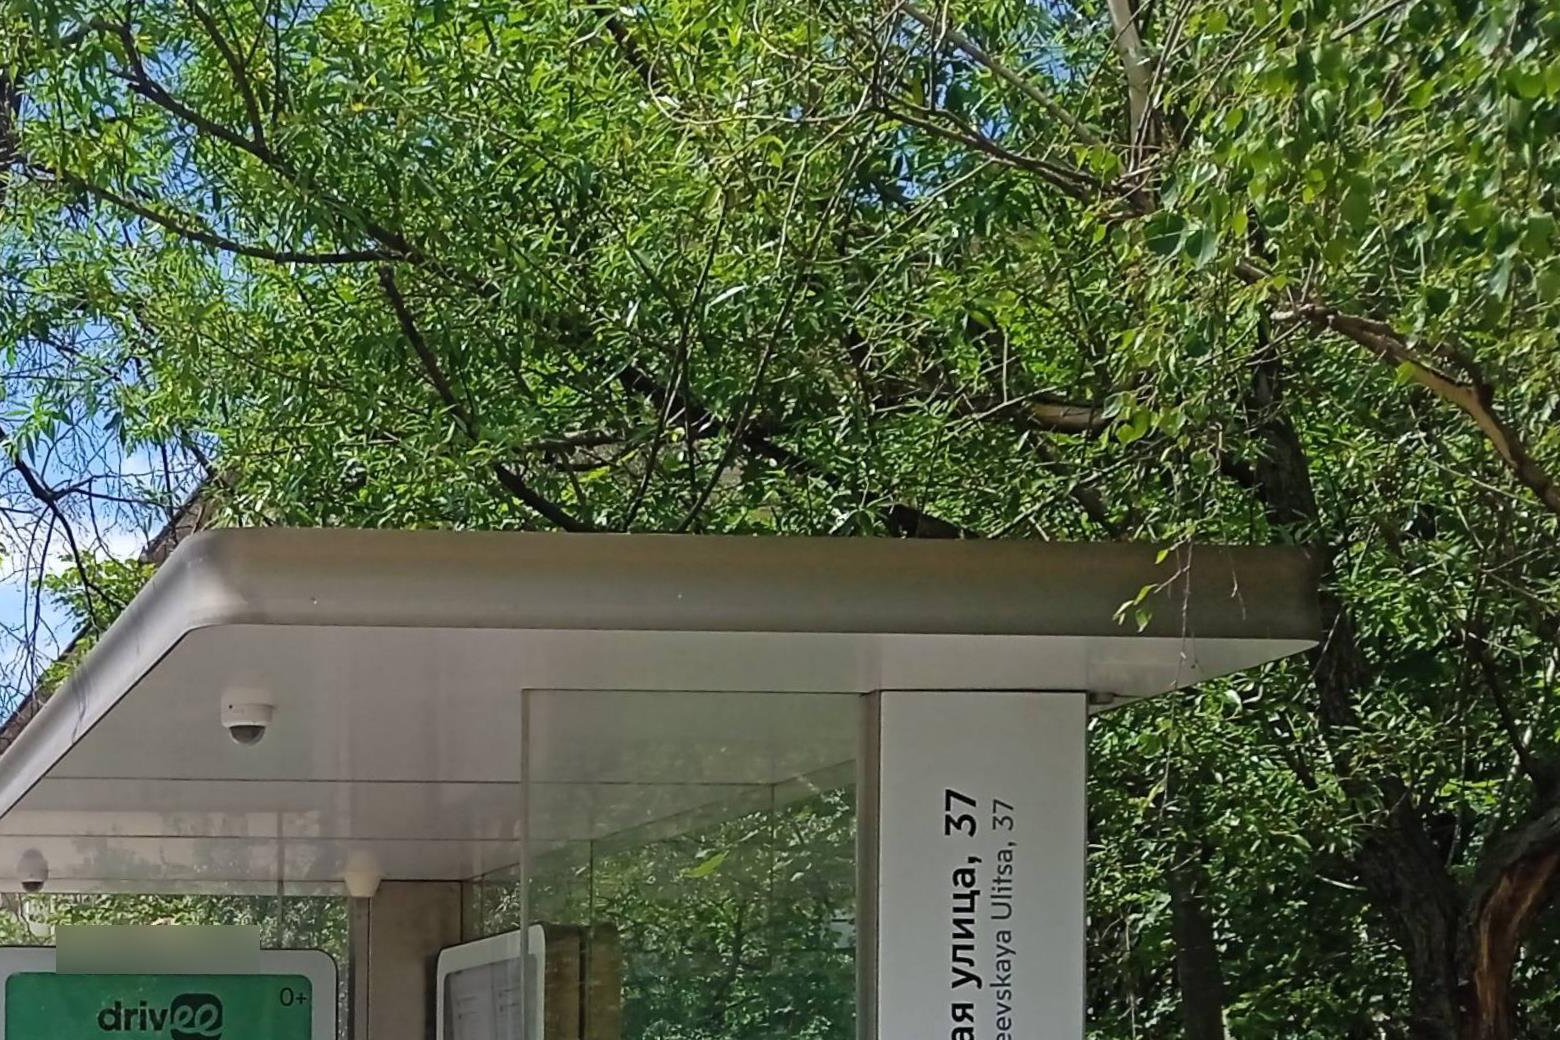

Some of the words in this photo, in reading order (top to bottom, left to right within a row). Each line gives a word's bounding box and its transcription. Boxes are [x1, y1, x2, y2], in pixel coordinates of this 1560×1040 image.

[944, 788, 977, 838] 37
[992, 798, 1015, 832] 37
[990, 841, 1018, 920] Ulitsa,
[951, 856, 983, 989] улица,
[279, 986, 308, 1007] 0+
